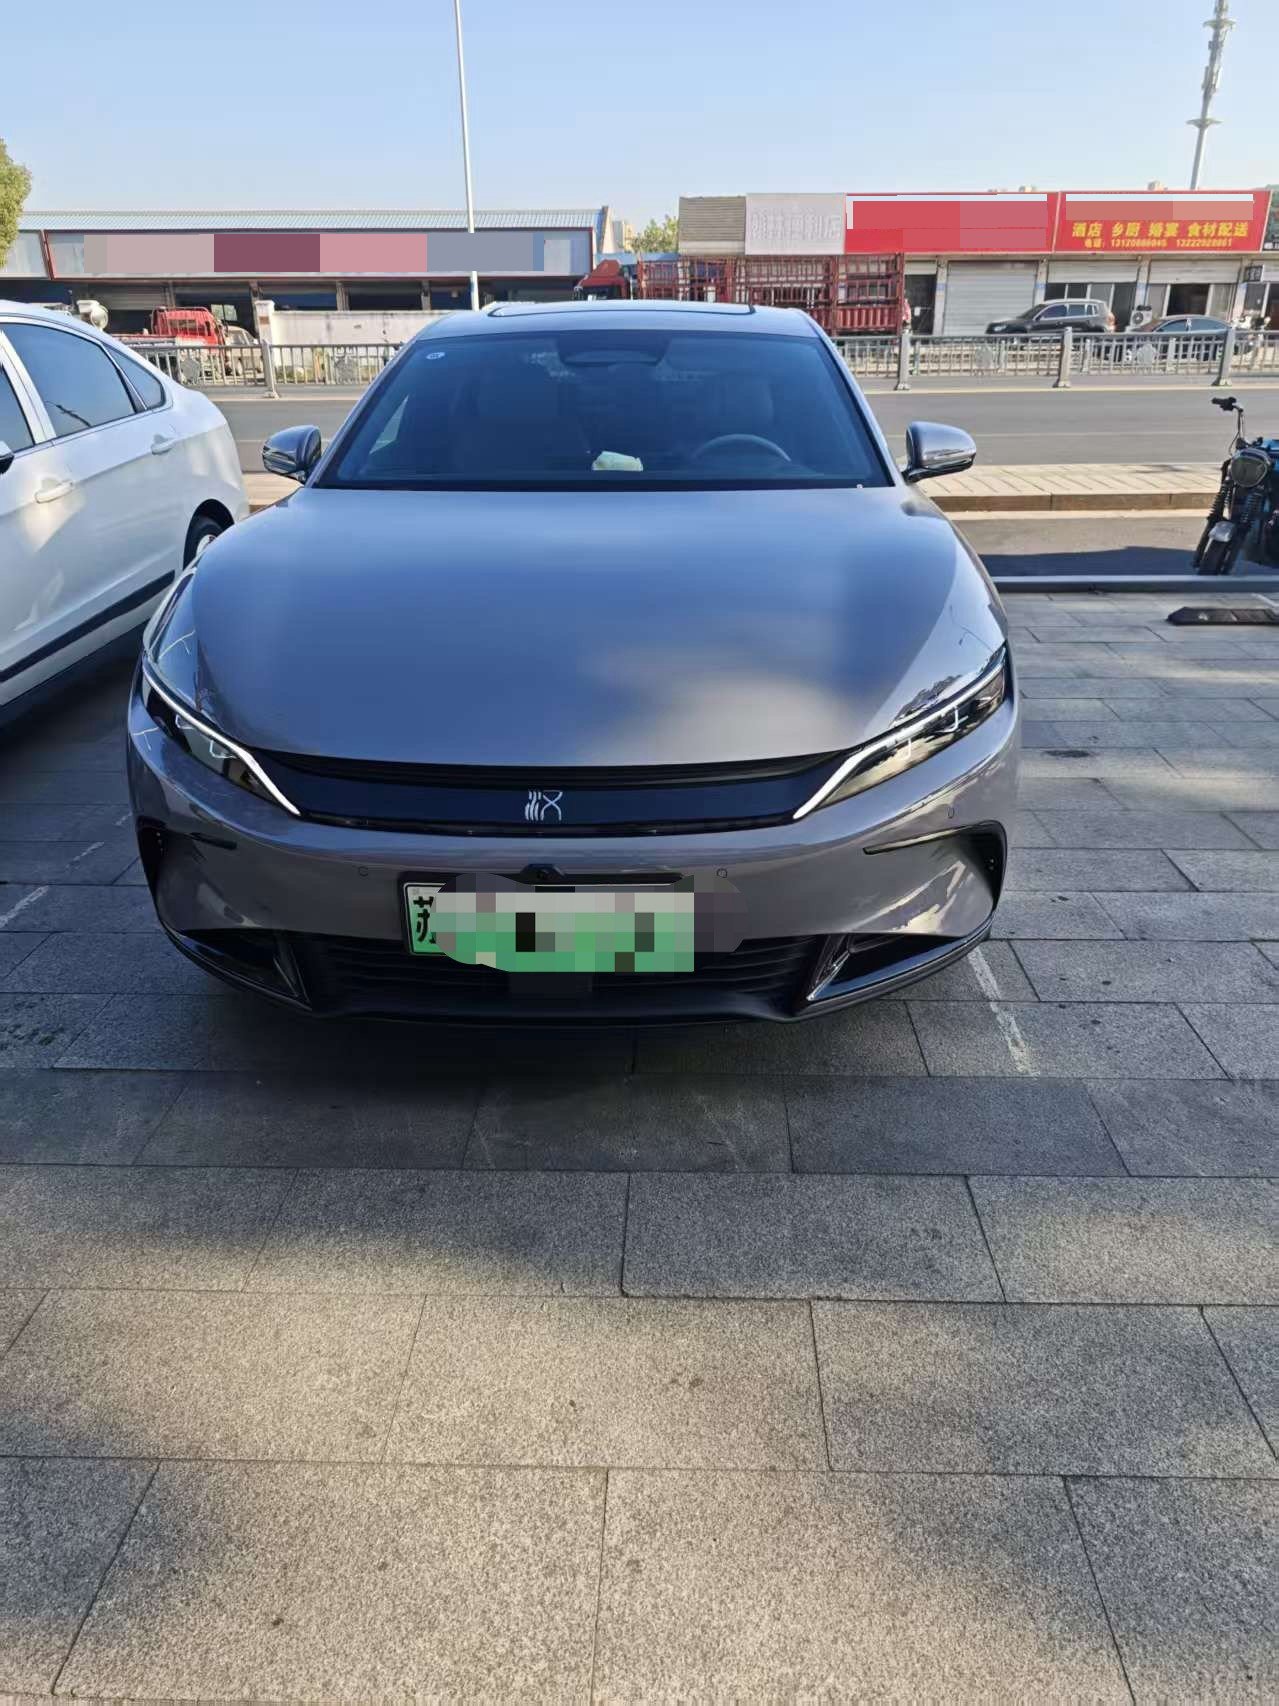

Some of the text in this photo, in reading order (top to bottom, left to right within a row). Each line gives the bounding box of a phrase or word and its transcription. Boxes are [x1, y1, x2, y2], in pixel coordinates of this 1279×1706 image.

[1072, 222, 1102, 238] 酒店
[1149, 222, 1179, 238] 婚宴
[1188, 222, 1248, 238] 食材配送
